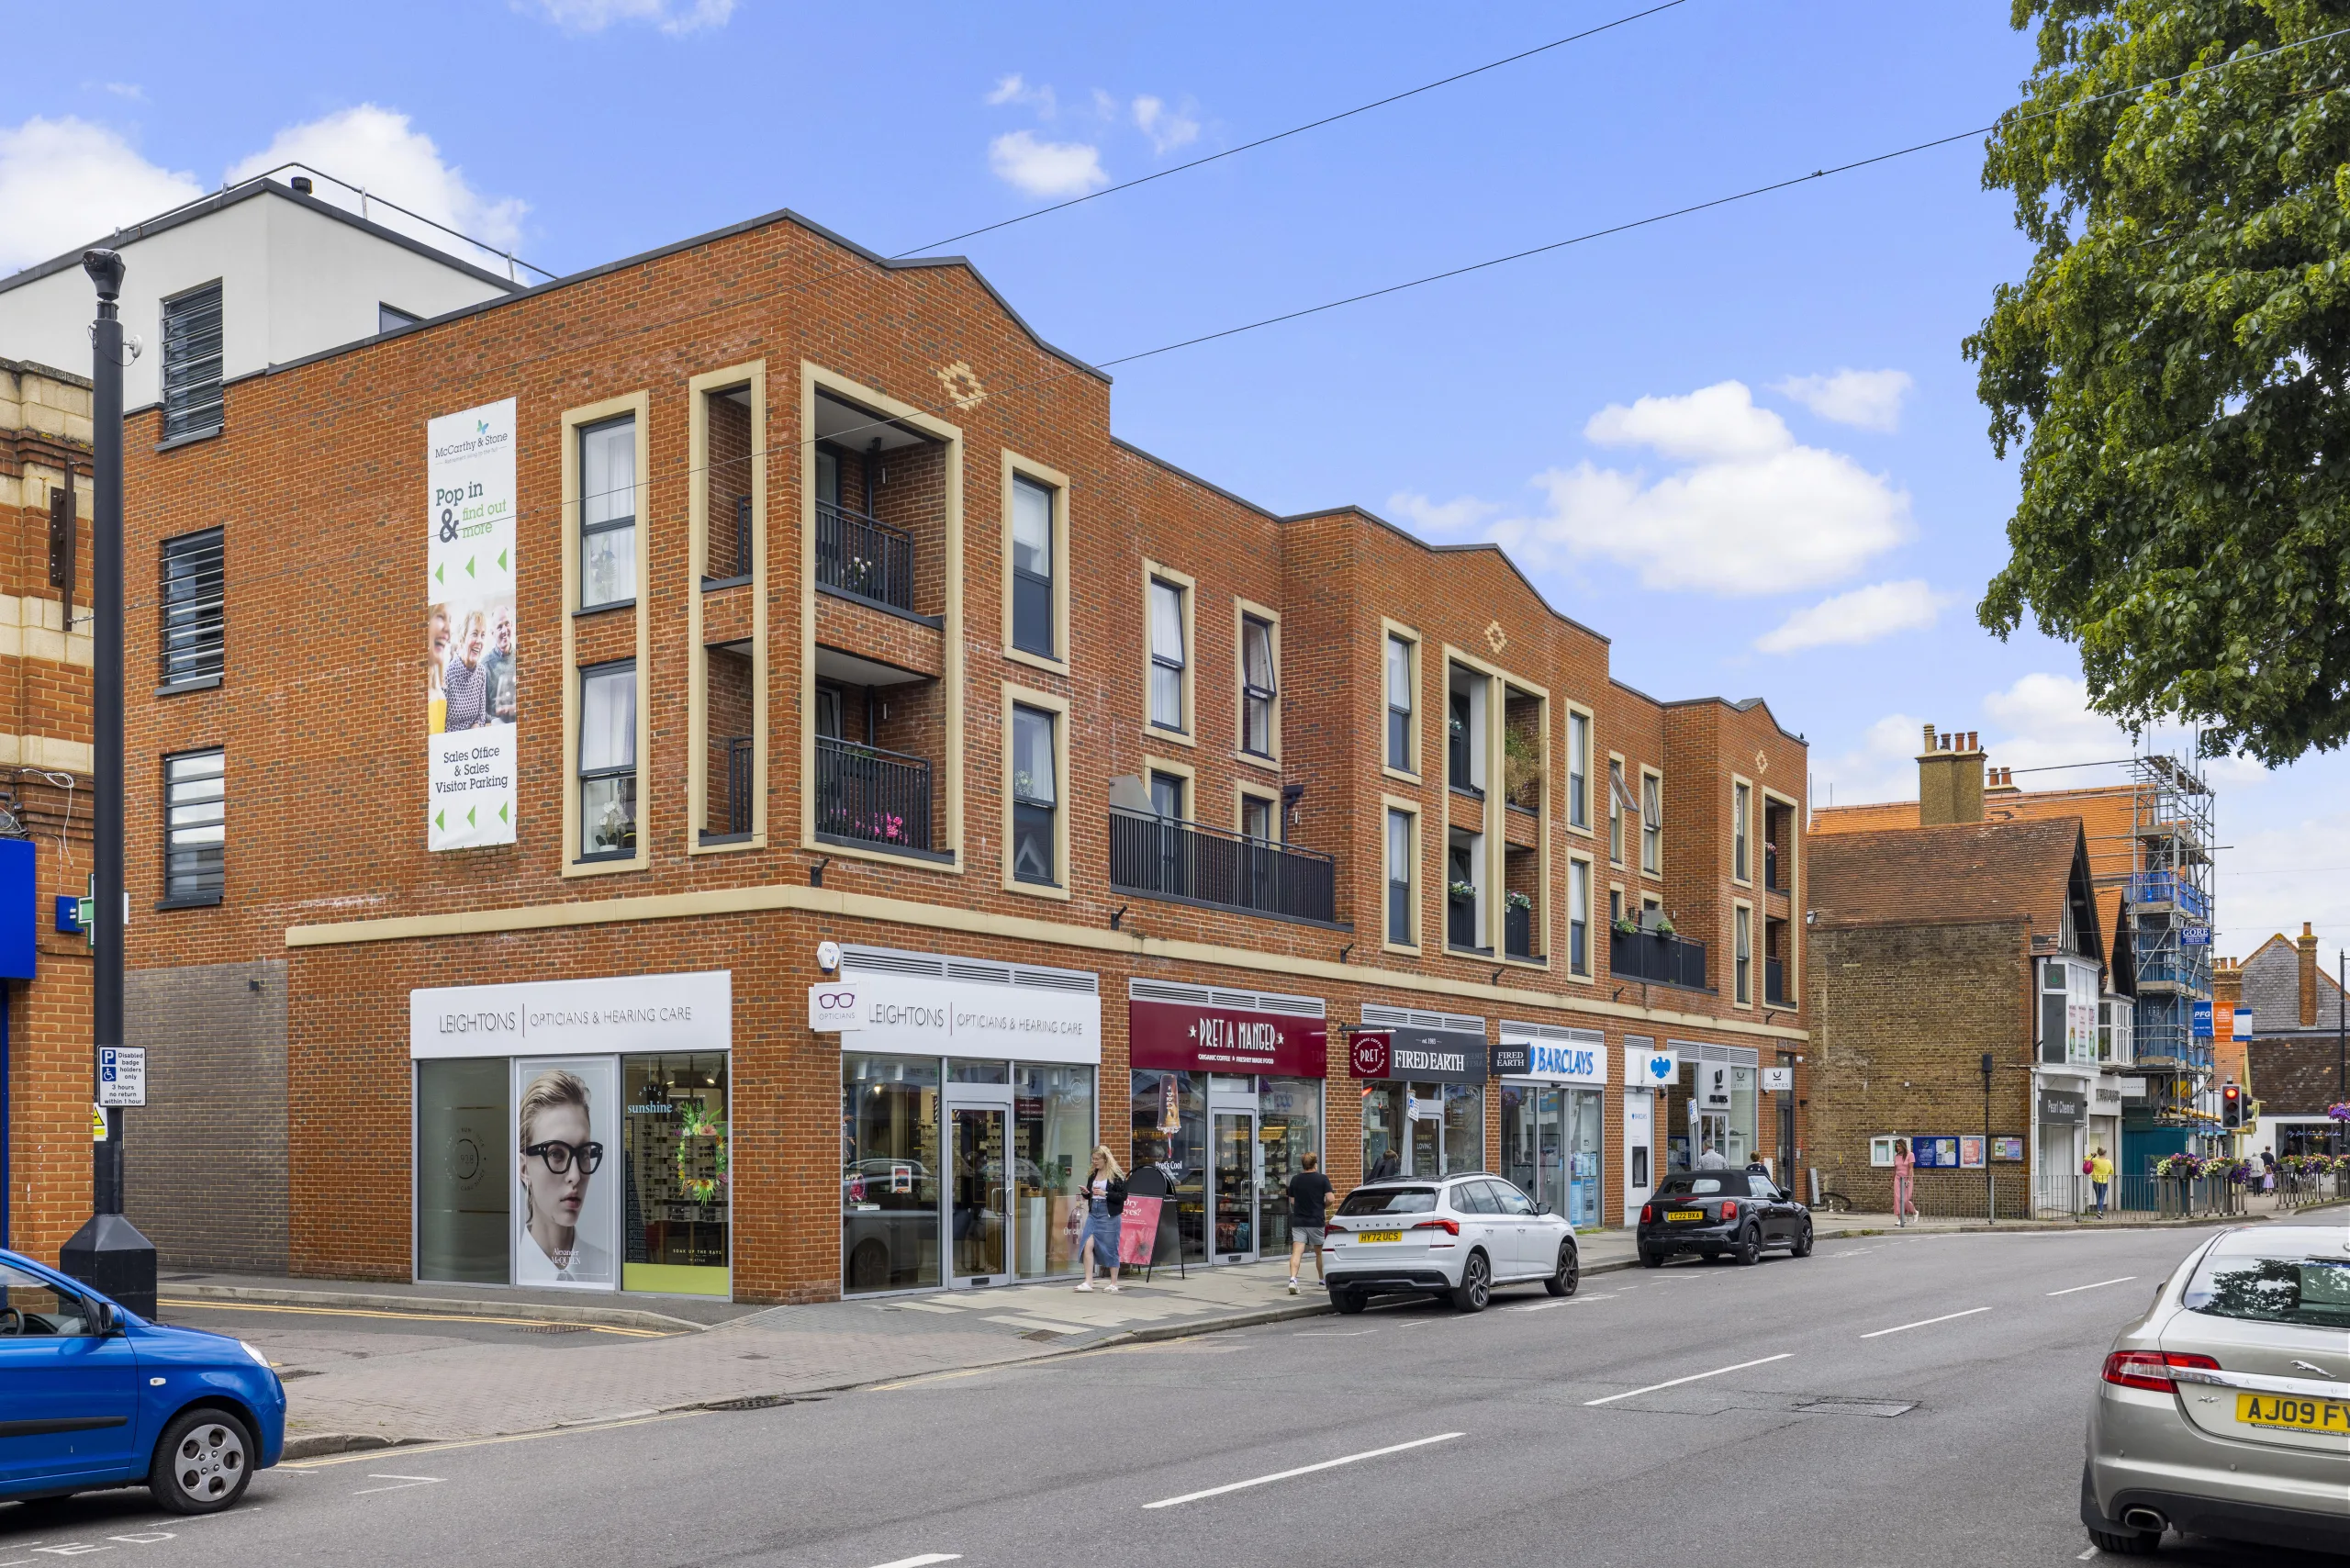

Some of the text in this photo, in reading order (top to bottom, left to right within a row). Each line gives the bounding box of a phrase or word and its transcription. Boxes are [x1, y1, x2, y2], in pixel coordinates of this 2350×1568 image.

[435, 433, 508, 458] McCarthy & Stone
[436, 481, 483, 507] Pop in
[440, 498, 507, 543] & find out
[463, 521, 492, 538] more
[444, 746, 499, 764] Sales Office
[454, 763, 490, 777] & Sales
[435, 775, 509, 793] Visitor Parking
[439, 1006, 692, 1034] LEIGHTONS OPTICIANS & HEARING CARE
[819, 1012, 856, 1021] OPTICIANS
[868, 1002, 1083, 1036] LEIGHTONS OPTICIANS & HEARING CARE
[1199, 1017, 1276, 1051] PRET A MANGER
[1355, 1037, 1383, 1050] ORGANIC COFFEE
[1360, 1048, 1379, 1062] PRET
[1394, 1049, 1464, 1071] FIRED EARTH
[1538, 1047, 1594, 1075] BARCLAYS
[628, 1101, 672, 1114] sunshine
[2048, 1100, 2075, 1114] Pearl Chemist
[1170, 1160, 1182, 1170] Cool
[1361, 1232, 1398, 1241] HY72 UCS
[553, 1248, 580, 1256] Alexander
[2248, 1397, 2315, 1424] AJ09
